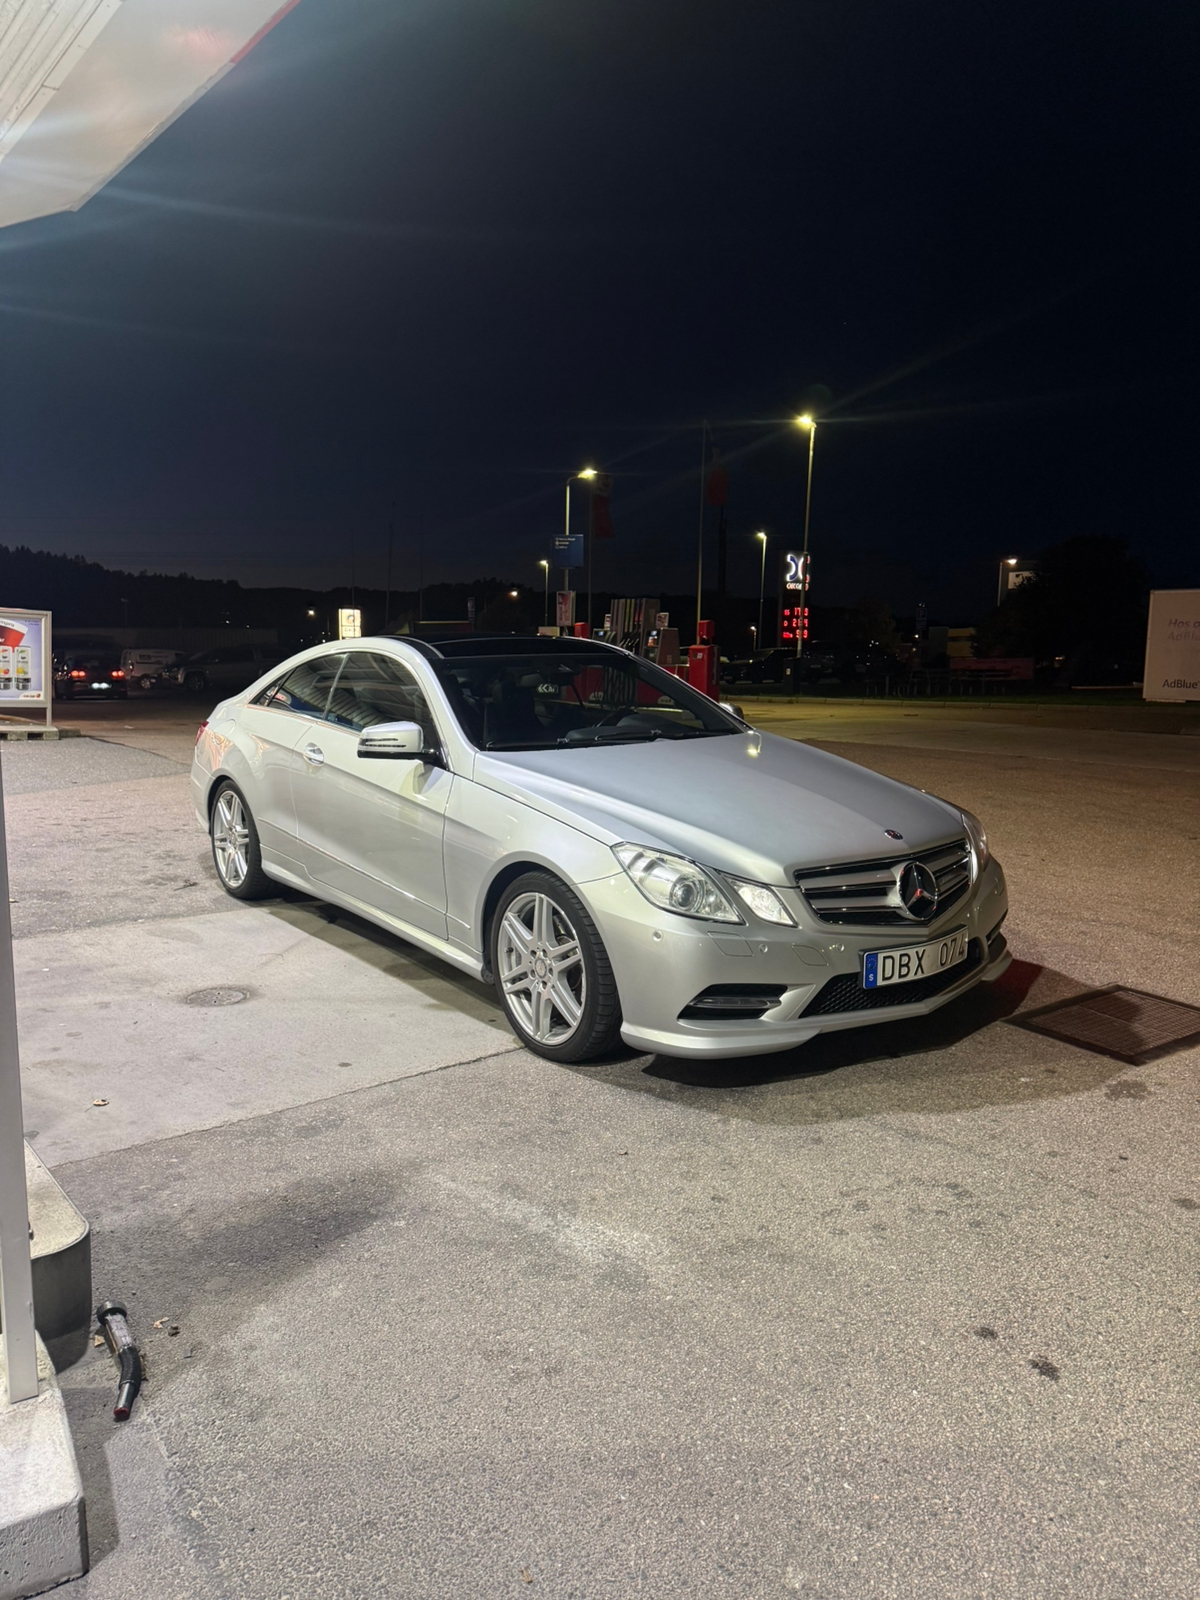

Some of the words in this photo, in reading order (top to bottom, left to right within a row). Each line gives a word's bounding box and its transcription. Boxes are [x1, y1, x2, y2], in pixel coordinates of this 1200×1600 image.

[1168, 618, 1190, 628] Hos
[1162, 679, 1198, 689] AdBlue
[881, 949, 926, 982] DBX
[938, 933, 965, 967] 074
[868, 973, 874, 982] S
